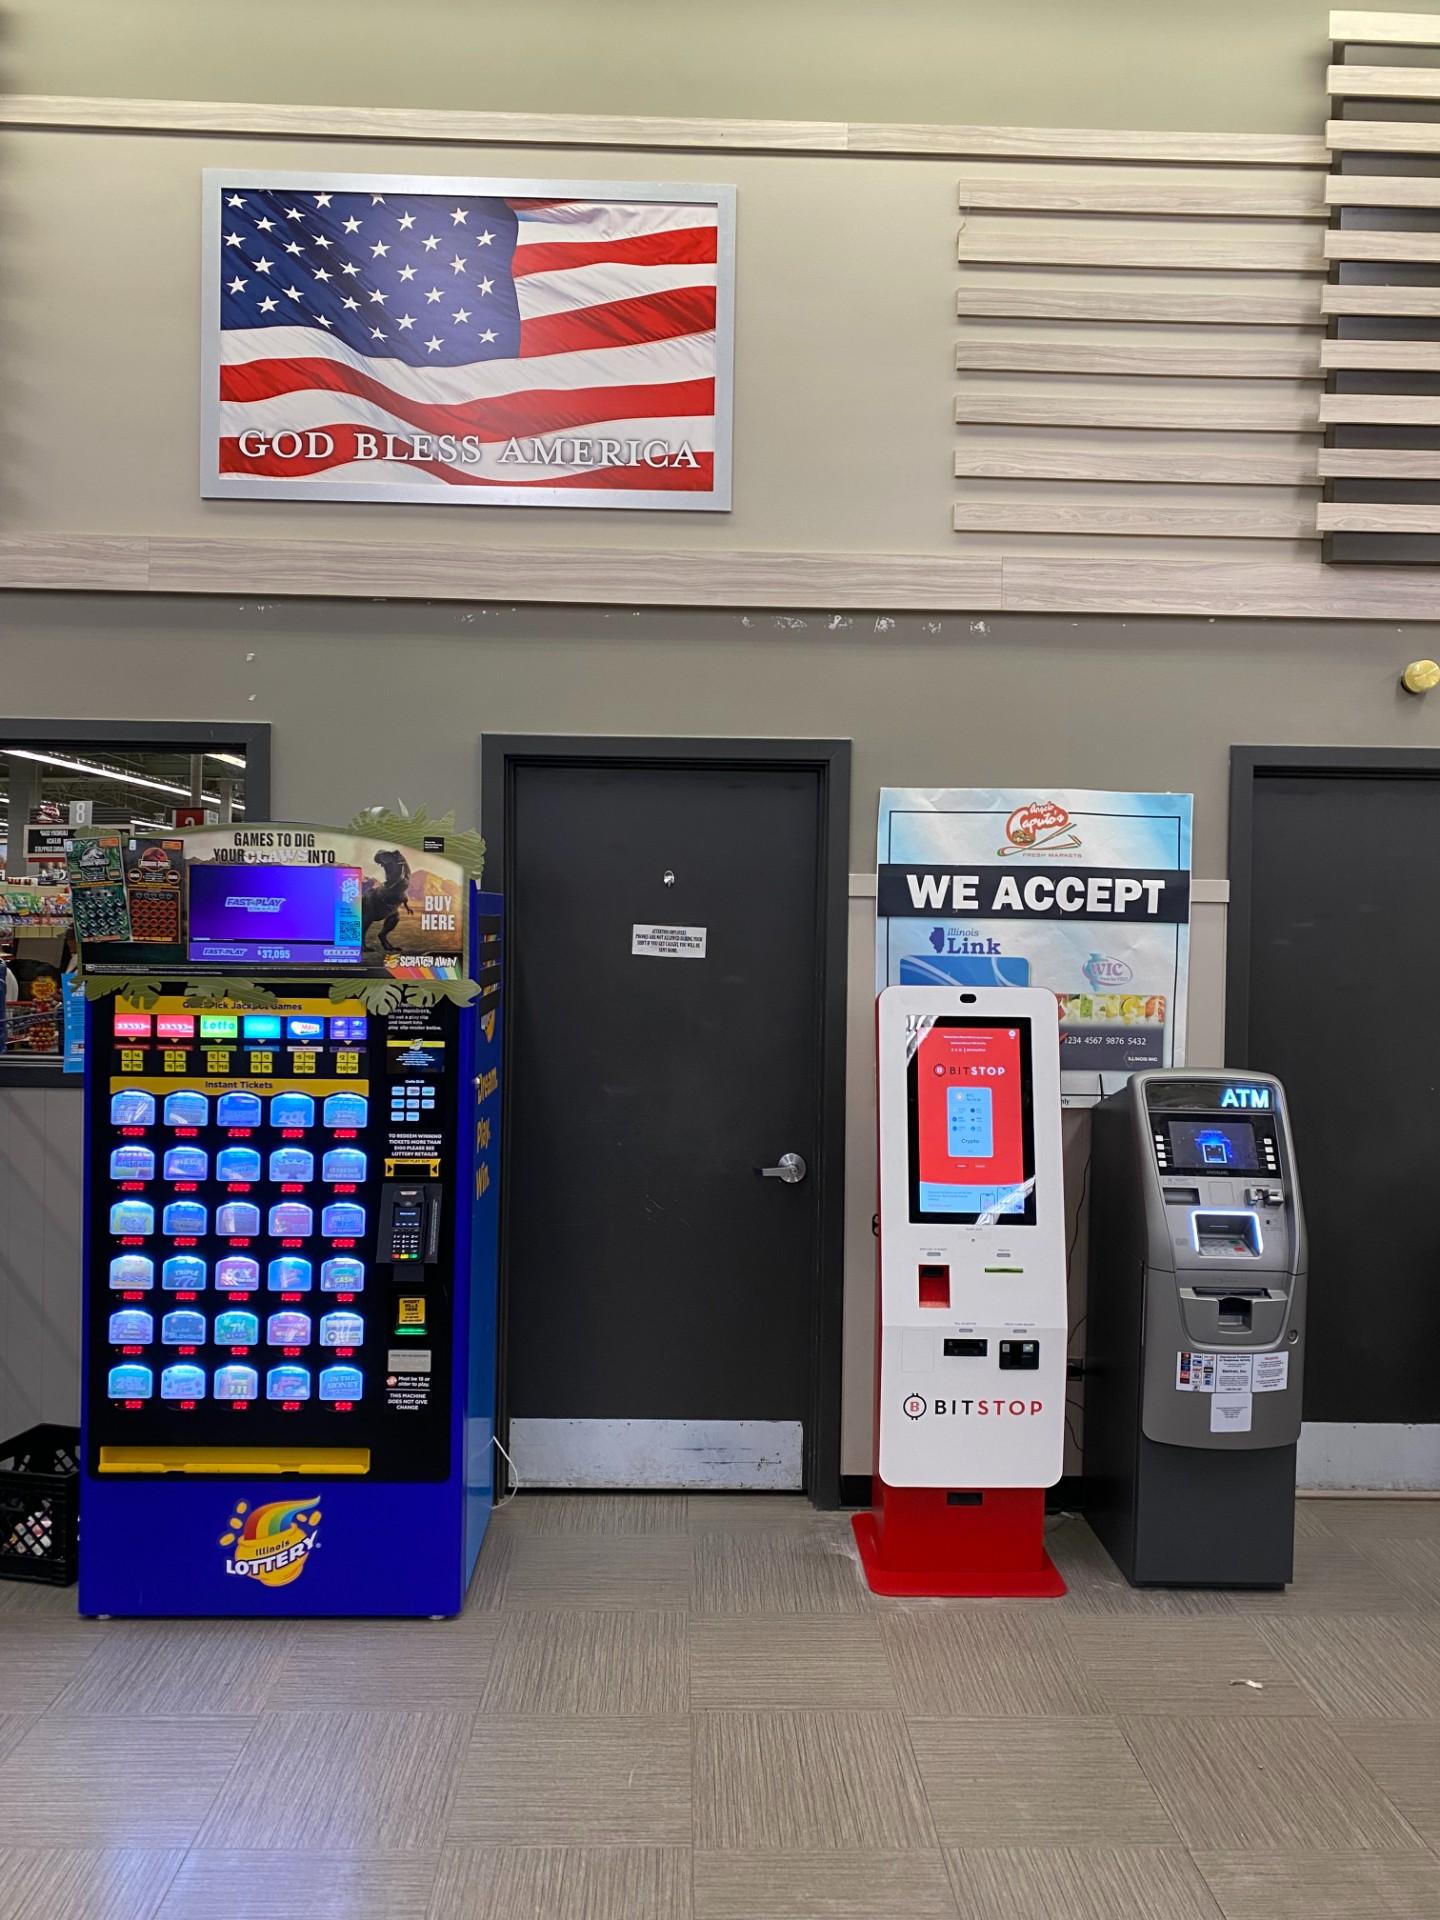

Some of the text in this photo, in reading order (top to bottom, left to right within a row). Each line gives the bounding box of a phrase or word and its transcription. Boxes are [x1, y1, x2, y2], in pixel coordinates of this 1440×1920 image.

[239, 430, 701, 468] GOD BLESS AMERICA
[234, 832, 315, 848] GAMES TO DIG
[213, 848, 245, 862] YOUR
[308, 850, 336, 864] INTO
[906, 874, 1166, 914] WE ACCEPT
[425, 896, 453, 911] BUY
[421, 914, 455, 931] HERE
[947, 937, 1002, 955] Link
[400, 956, 458, 968] SCRATCH AWAY
[1091, 963, 1123, 976] WIC
[271, 1002, 303, 1010] Games
[203, 1021, 236, 1030] Lotto
[1064, 1036, 1146, 1045] 1234 4567 9876 5432
[949, 1066, 1005, 1076] BITSTOP
[1221, 1088, 1269, 1108] ATM
[934, 1399, 1043, 1416] BITSTOP
[226, 1530, 318, 1575] LOTTERY
[255, 1540, 290, 1556] Illinois
